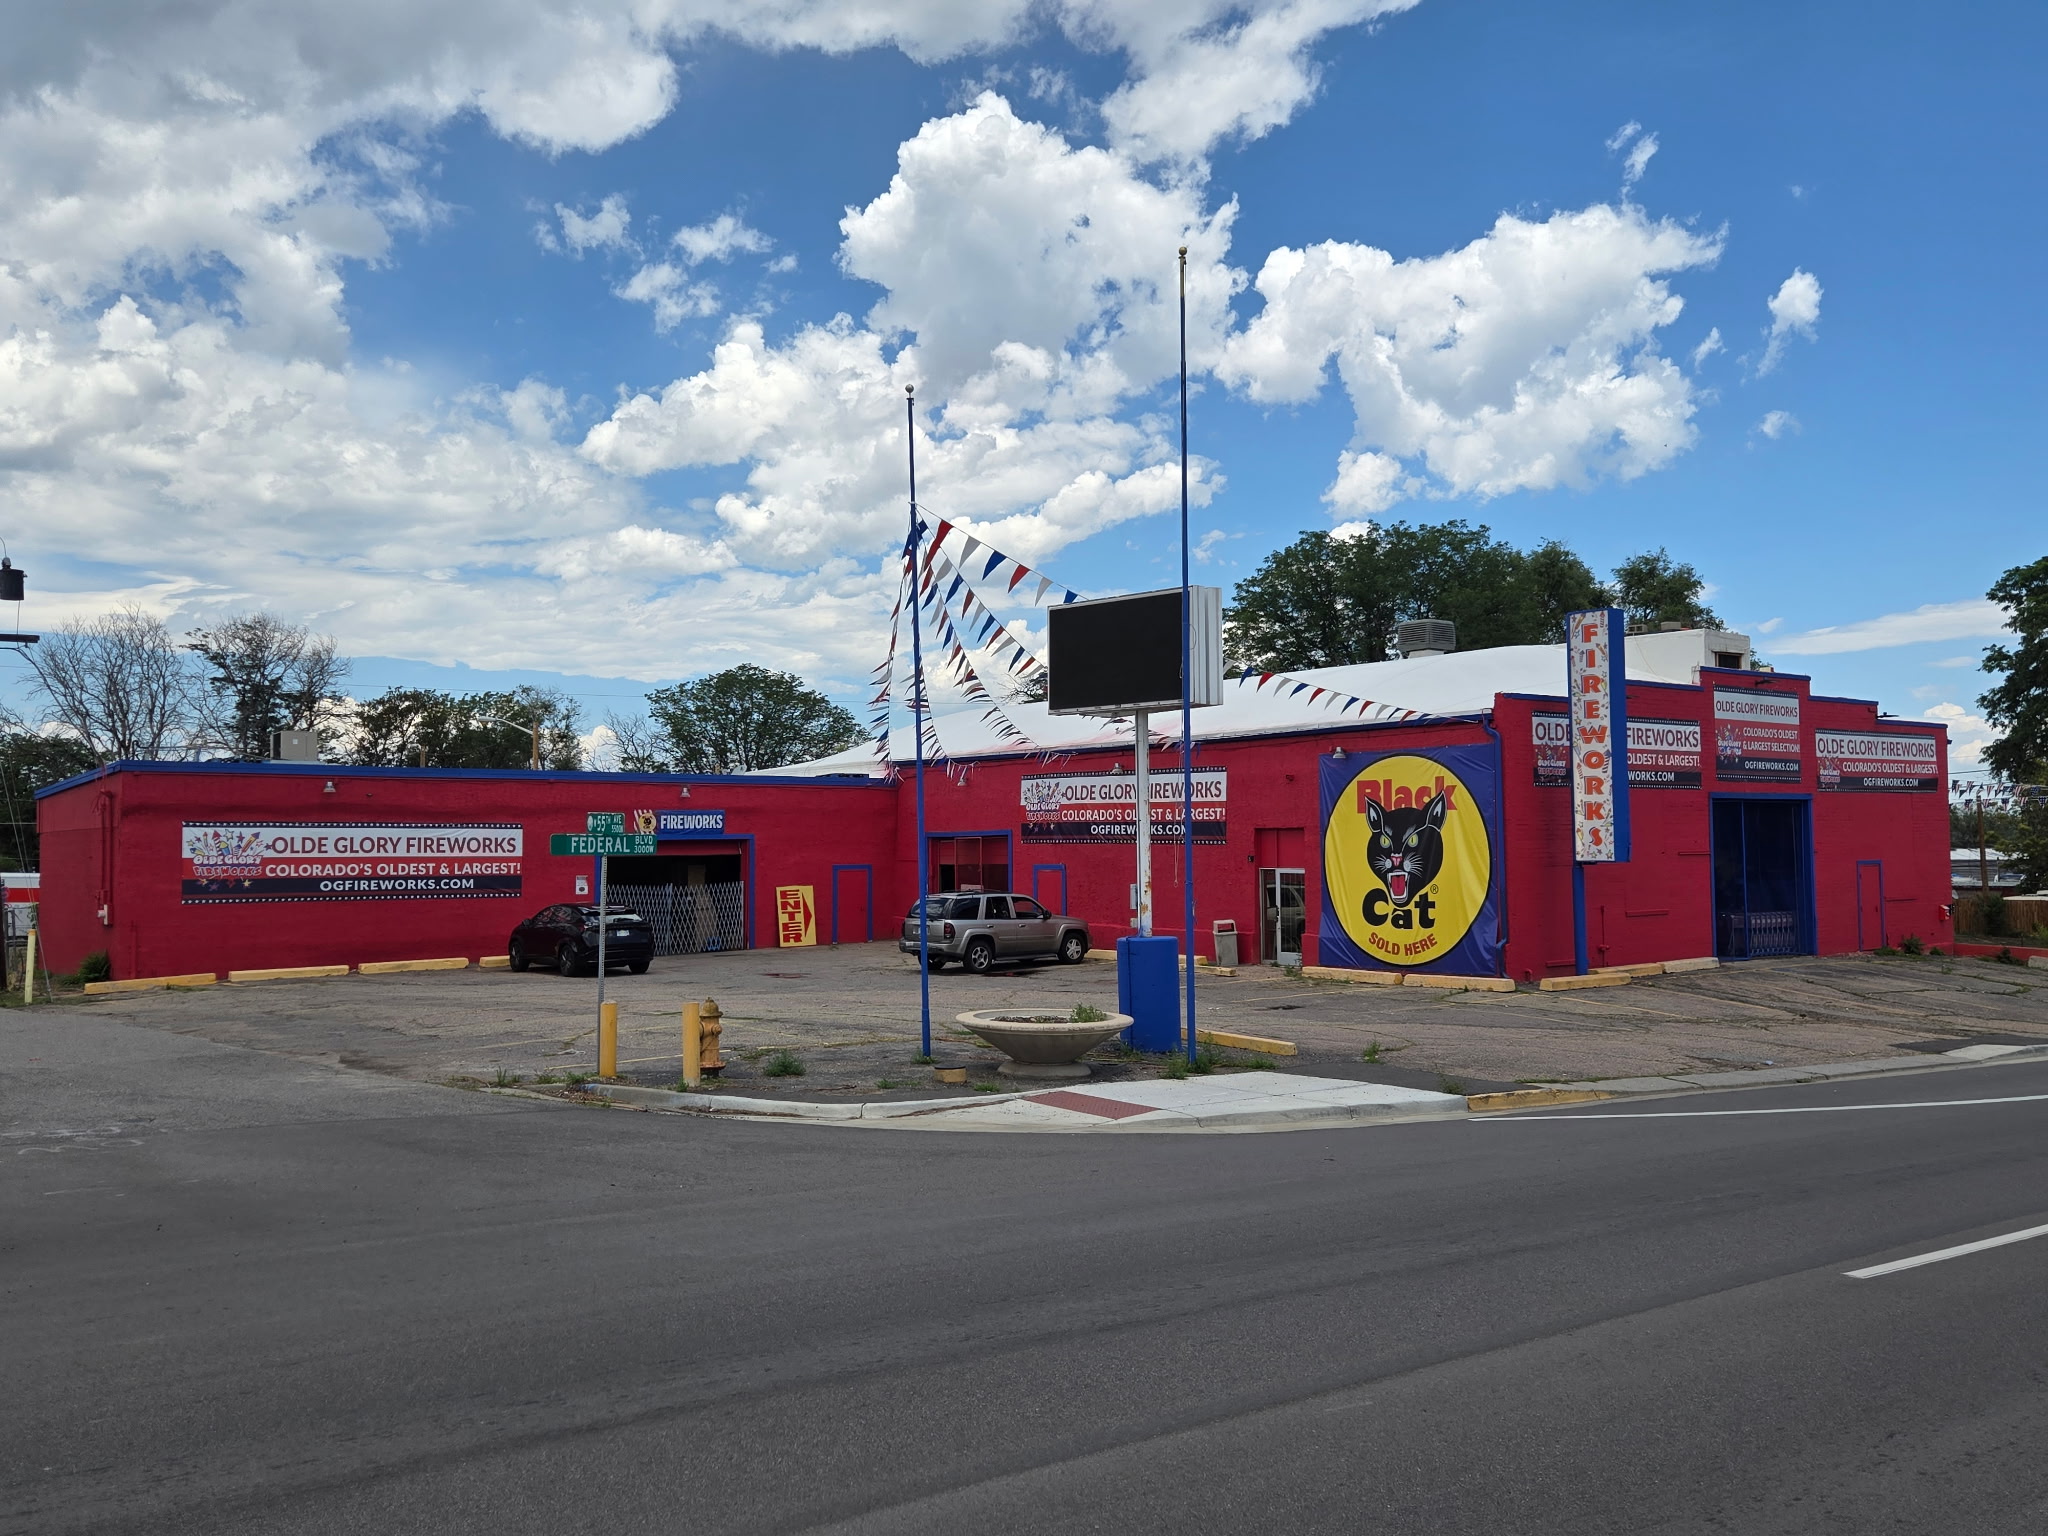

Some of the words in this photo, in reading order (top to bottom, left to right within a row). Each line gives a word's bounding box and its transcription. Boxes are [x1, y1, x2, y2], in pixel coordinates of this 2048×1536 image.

[1716, 700, 1735, 713] OLDE
[1736, 702, 1759, 715] GLORY
[1759, 704, 1798, 718] FIREWORKS
[1578, 623, 1608, 848] FIREWORKS
[1743, 727, 1777, 738] COLORADO'S
[1778, 730, 1798, 740] OLDEST
[1743, 741, 1748, 750] &
[1748, 741, 1771, 752] LARGEST
[1817, 738, 1845, 755] OLDE
[1847, 739, 1880, 757] GLORY
[1881, 740, 1935, 759] FIREWORKS
[1627, 753, 1656, 766] OLDEST
[1658, 754, 1664, 766] &
[1665, 755, 1700, 767] LARGEST!
[1744, 761, 1799, 771] OGFIREWORKS.COM
[1842, 762, 1882, 773] COLORADO'S
[1882, 763, 1905, 774] OLDEST
[1905, 764, 1911, 773] &
[1911, 764, 1938, 775] LARGEST!
[1863, 777, 1919, 787] OGFIREWORKS.COM
[1065, 785, 1096, 801] OLDE
[1148, 781, 1222, 799] IREWRKS
[1357, 776, 1458, 814] Black
[613, 815, 622, 824] AVE
[1061, 808, 1122, 821] COLORADO'S
[1124, 808, 1163, 820] OLST
[1165, 808, 1173, 820] &
[660, 815, 723, 830] FIREWORKS
[1090, 824, 1186, 835] OGFIREWKS.CO
[272, 836, 328, 854] OLDE
[334, 836, 402, 854] GLORY
[406, 837, 516, 854] FIREWORKS
[571, 836, 631, 853] FEDERAL
[635, 836, 653, 845] BLVD
[633, 845, 654, 853] 3000W
[193, 855, 224, 865] OLDE
[225, 855, 263, 865] GLORY
[193, 866, 262, 876] FIREWORKS
[265, 863, 372, 877] COLORADO'S
[376, 863, 435, 876] OLDEST
[439, 863, 450, 875] &
[454, 863, 521, 875] LARGEST!
[320, 879, 474, 891] OGFIREWORKS.COM
[1362, 888, 1436, 930] Cat
[780, 889, 803, 943] ENTER
[1369, 932, 1400, 956] SOLD
[1404, 933, 1438, 956] HERE
